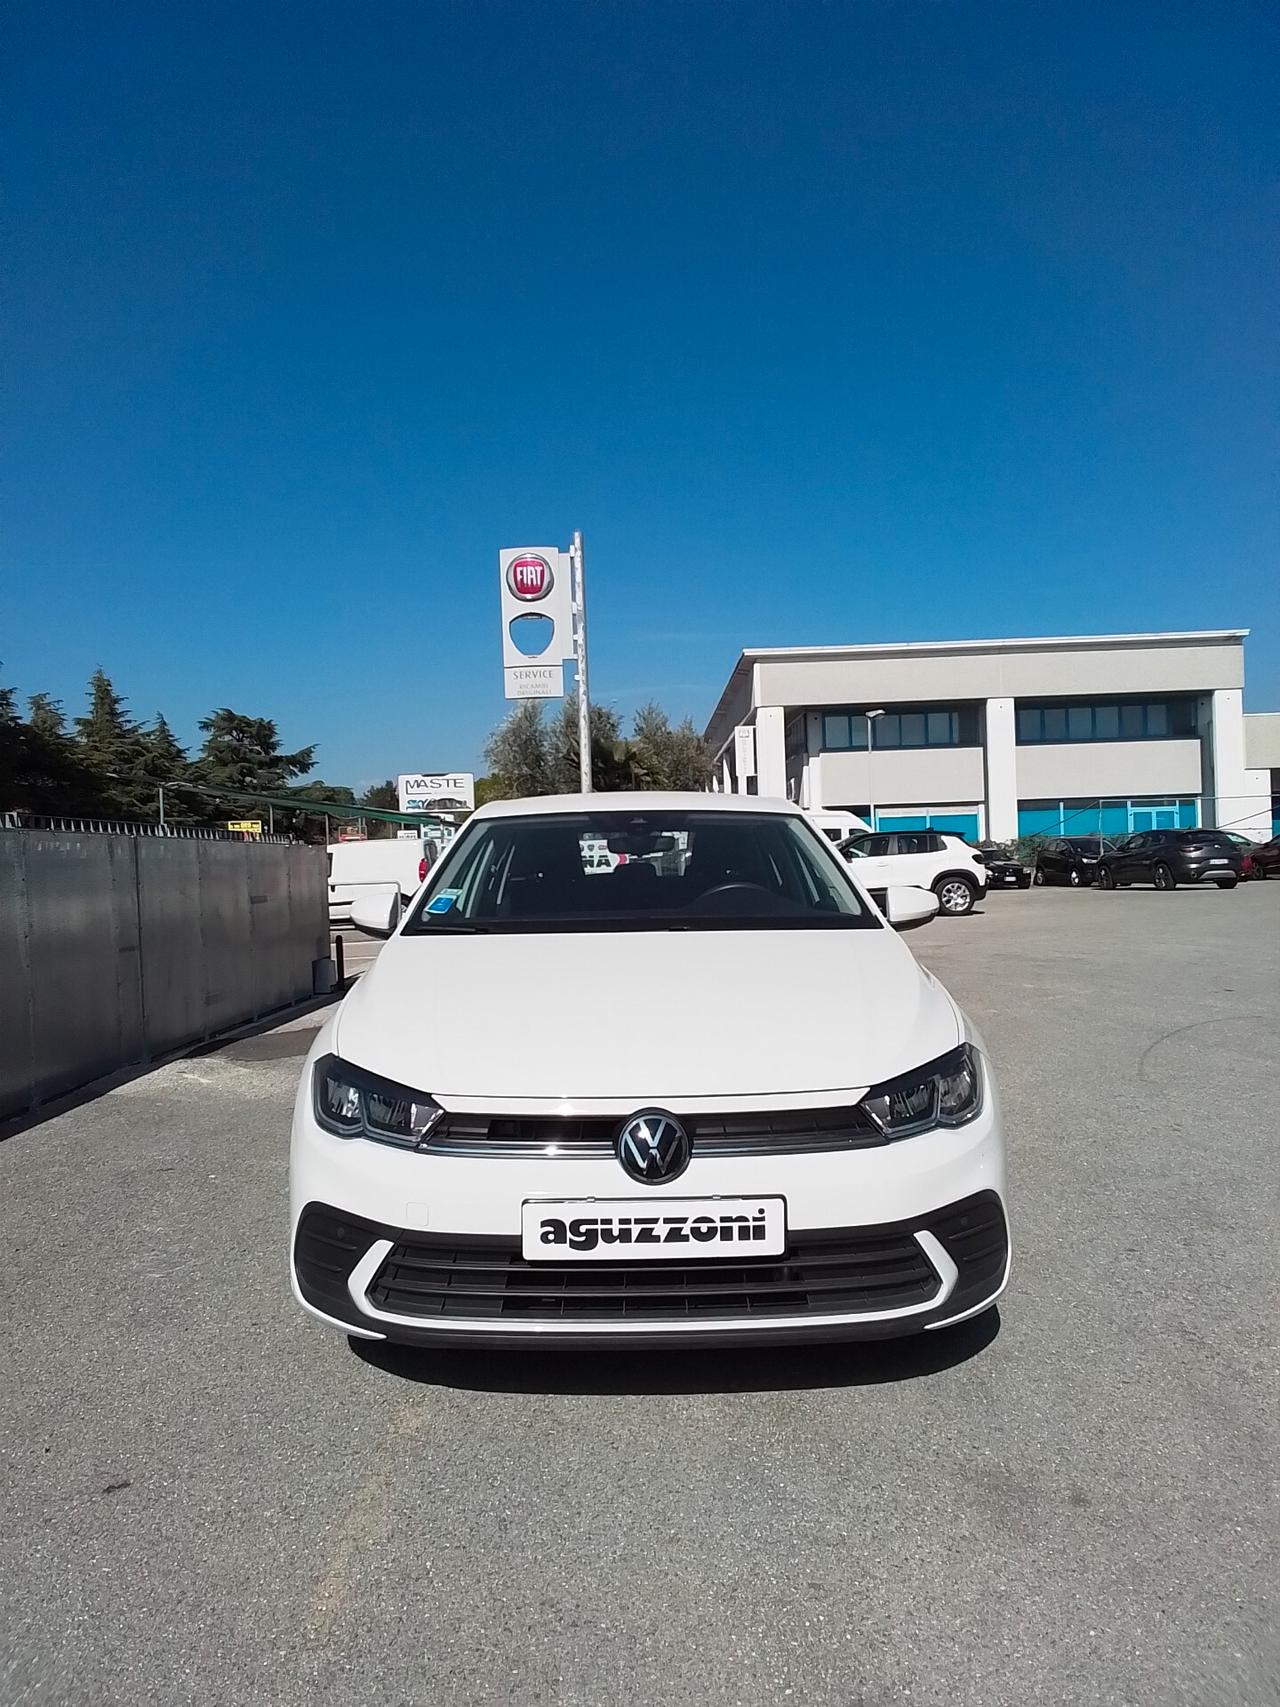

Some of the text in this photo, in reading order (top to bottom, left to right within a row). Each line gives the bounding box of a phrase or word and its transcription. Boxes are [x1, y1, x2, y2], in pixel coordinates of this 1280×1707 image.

[516, 566, 545, 587] FIAT
[513, 670, 553, 680] SERVICE
[405, 778, 465, 790] MASTE
[539, 1207, 767, 1252] aguzzoni
